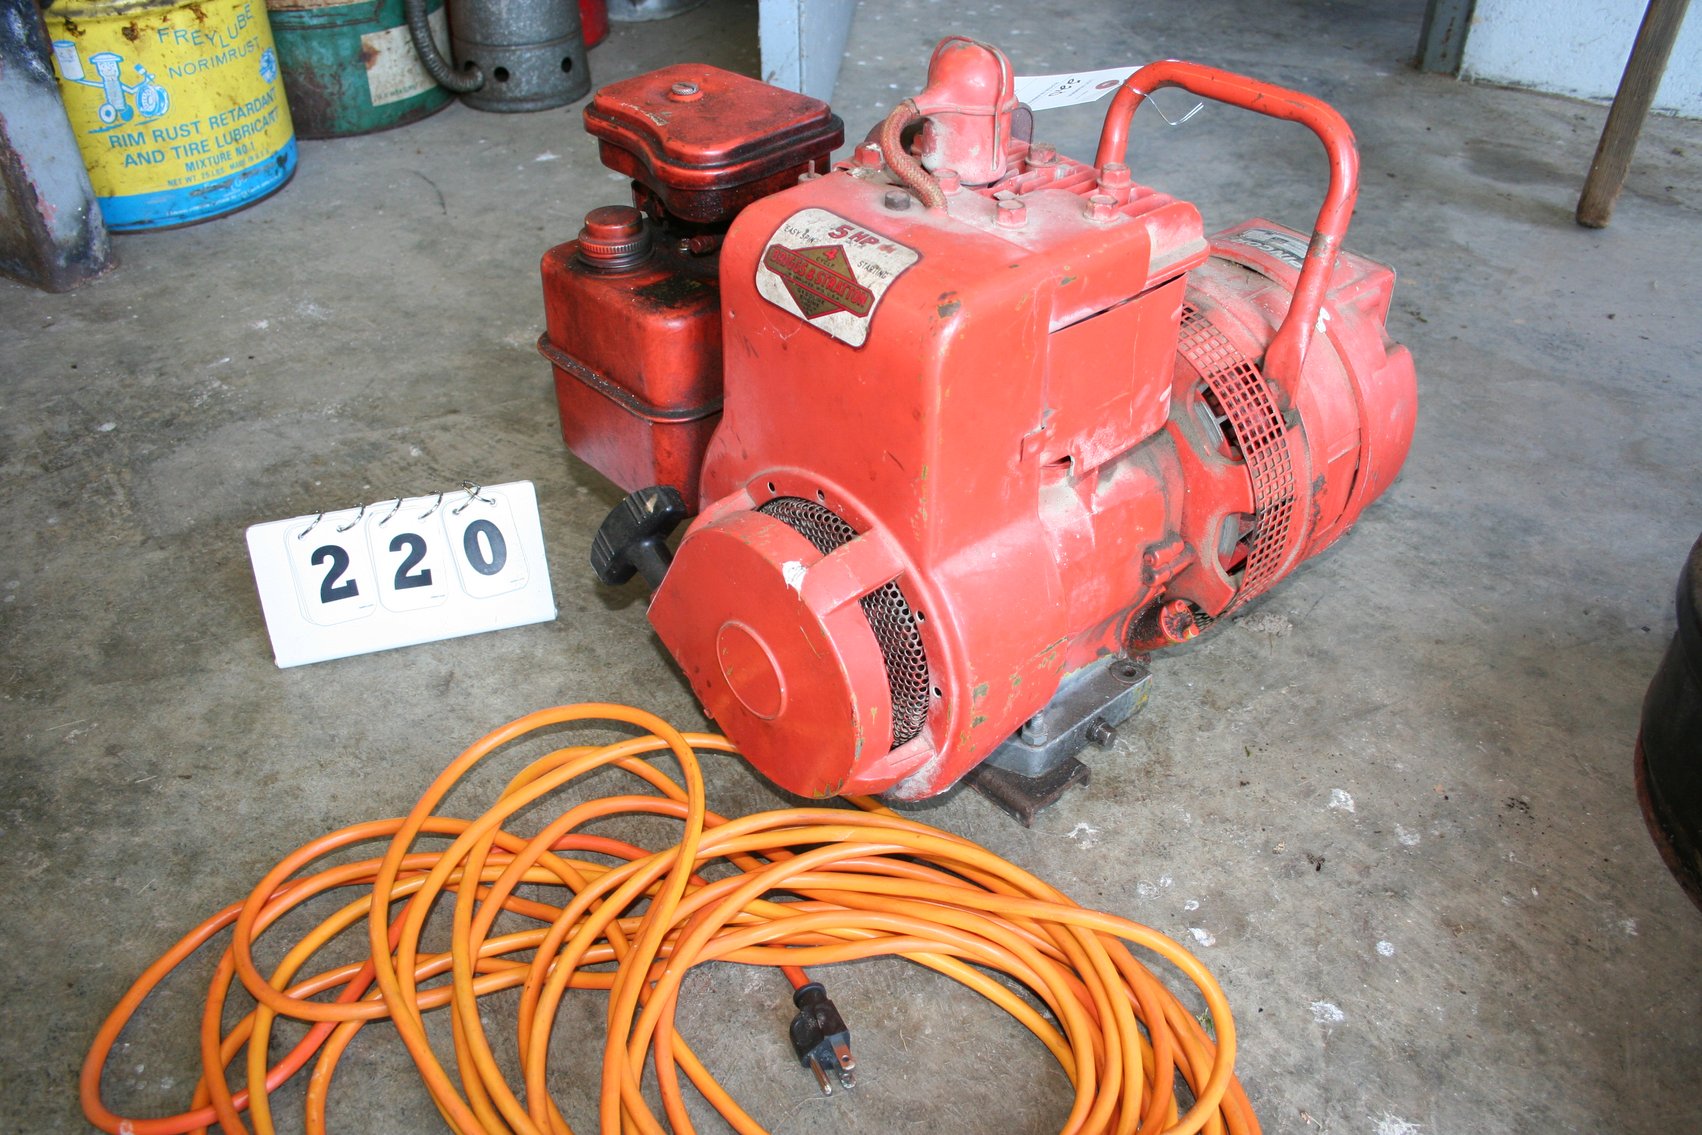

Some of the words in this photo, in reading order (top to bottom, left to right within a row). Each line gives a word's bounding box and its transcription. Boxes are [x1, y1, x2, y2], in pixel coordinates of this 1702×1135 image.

[157, 3, 254, 49] FREYLUBE
[168, 36, 260, 79] NORIMRUST
[109, 131, 147, 149] RIM
[152, 121, 201, 143] RUST
[208, 86, 276, 130] RETARDANT
[124, 149, 166, 168] AND
[170, 139, 211, 160] TIRE
[215, 106, 279, 149] LUBRICANT
[184, 151, 233, 172] MIXTURE
[823, 247, 839, 261] 4
[828, 224, 855, 239] 5
[848, 231, 880, 245] HP
[771, 249, 809, 277] BRIGGS
[805, 267, 817, 281] &
[815, 271, 869, 306] STRATTON
